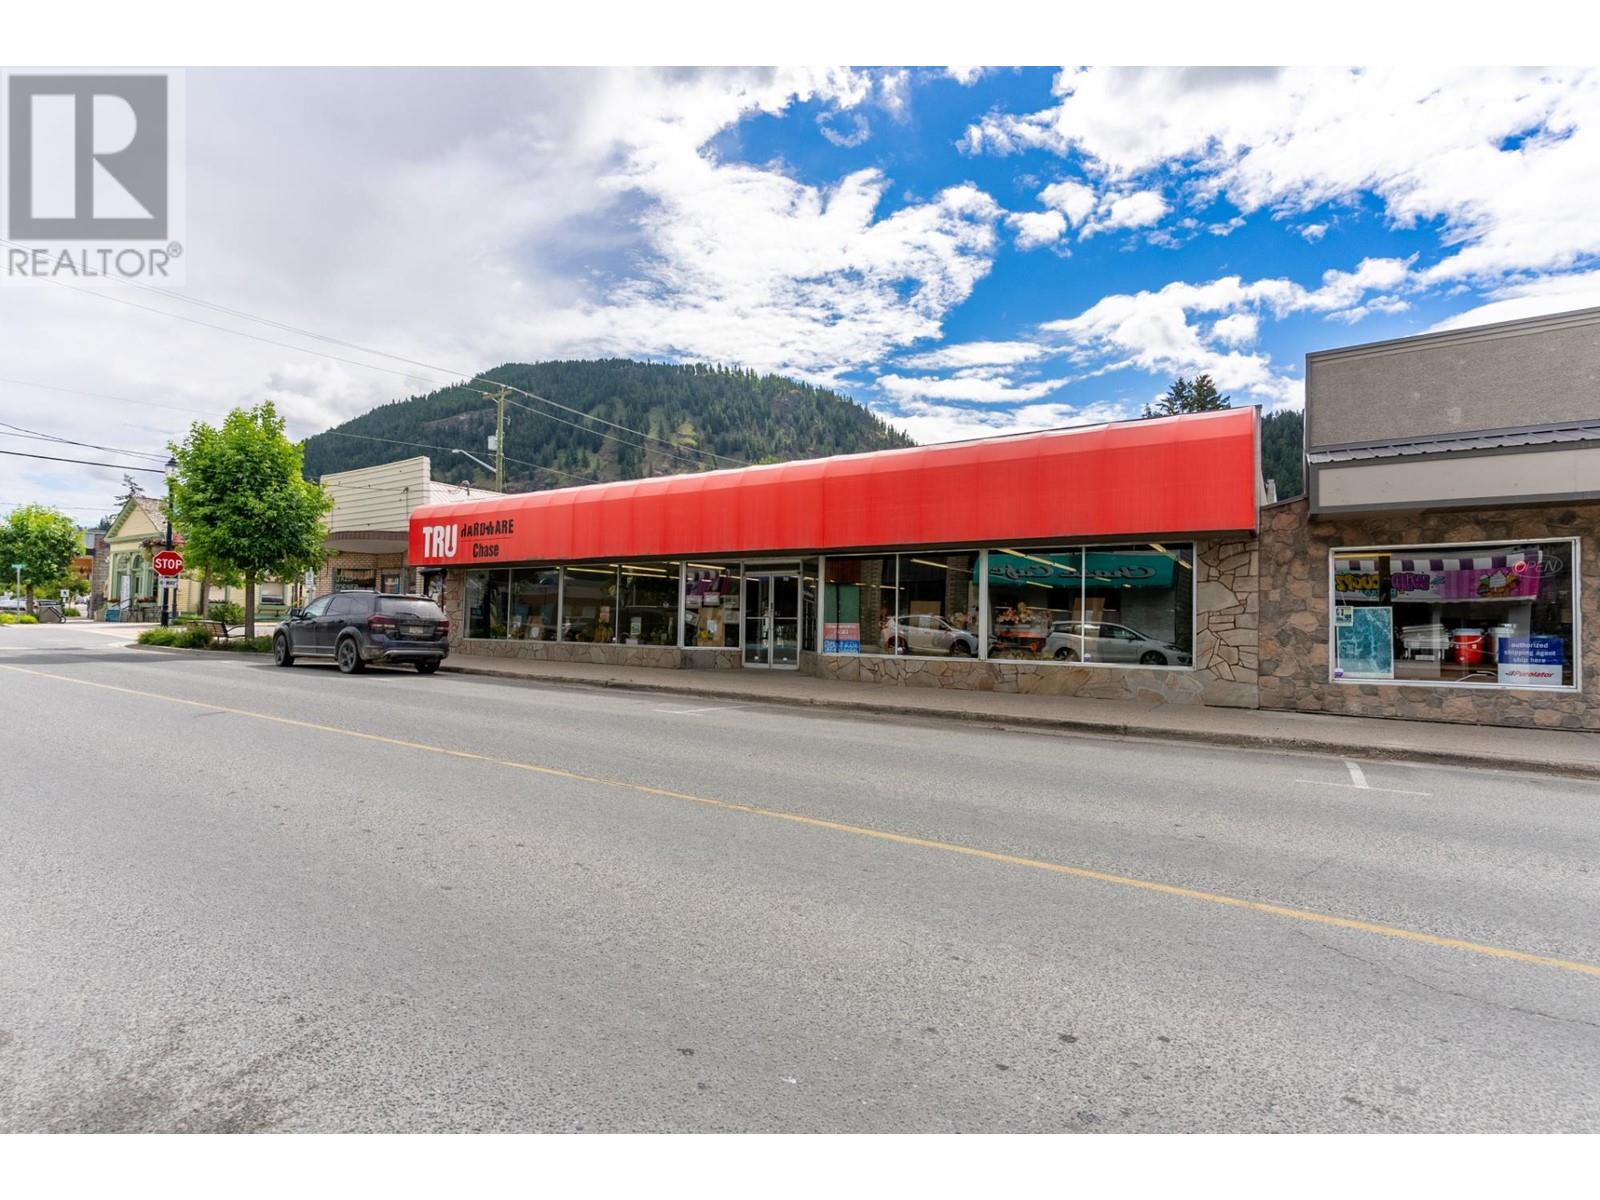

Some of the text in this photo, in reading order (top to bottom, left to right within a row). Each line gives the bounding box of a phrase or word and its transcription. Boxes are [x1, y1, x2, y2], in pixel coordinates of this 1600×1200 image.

[422, 523, 459, 558] TRU
[472, 543, 499, 558] Chase
[155, 558, 183, 570] STOP
[1514, 560, 1558, 573] OPEN
[1504, 649, 1534, 657] shipping
[1513, 670, 1554, 678] Purolator
